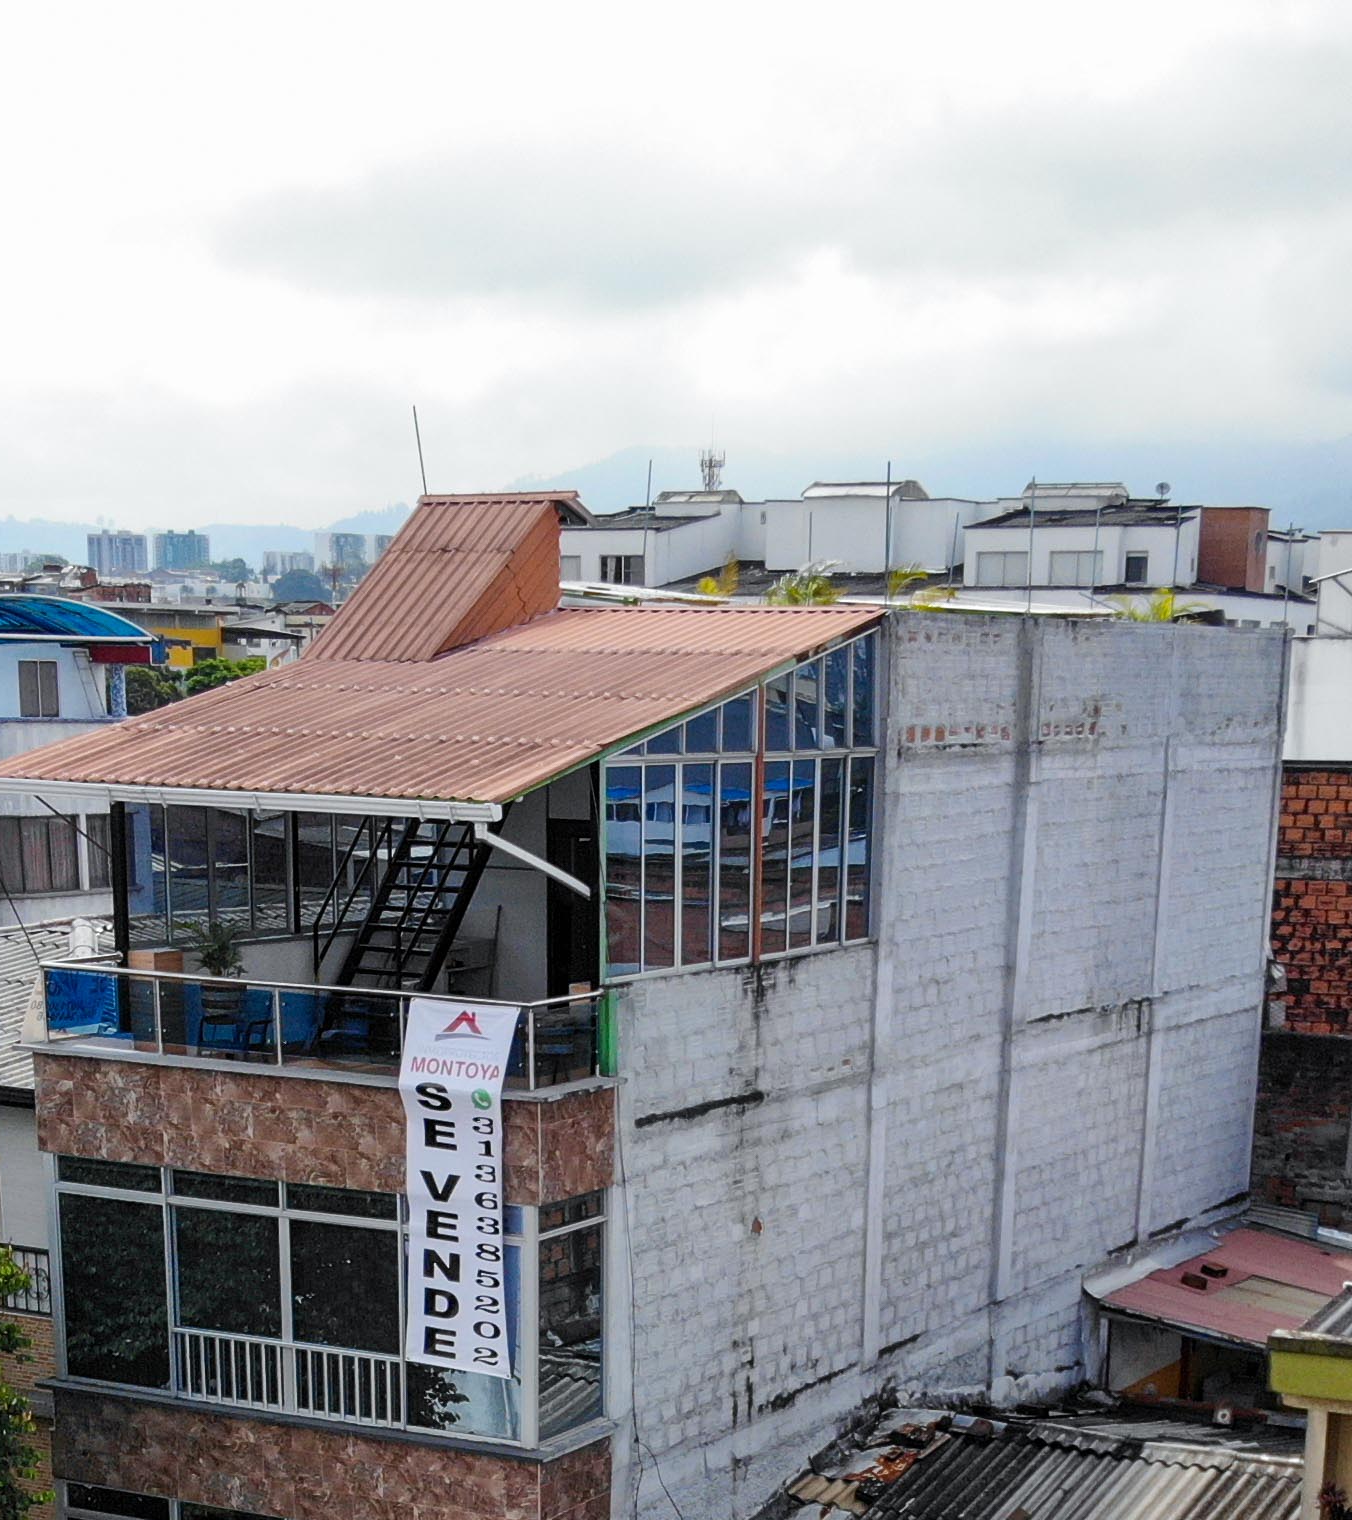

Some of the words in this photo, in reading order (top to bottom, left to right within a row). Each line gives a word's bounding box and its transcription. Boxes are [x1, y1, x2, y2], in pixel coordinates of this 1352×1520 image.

[411, 1056, 500, 1081] MONTOYA
[415, 1082, 458, 1152] SE
[419, 1169, 461, 1360] VENDE
[471, 1116, 501, 1367] 3136385202
